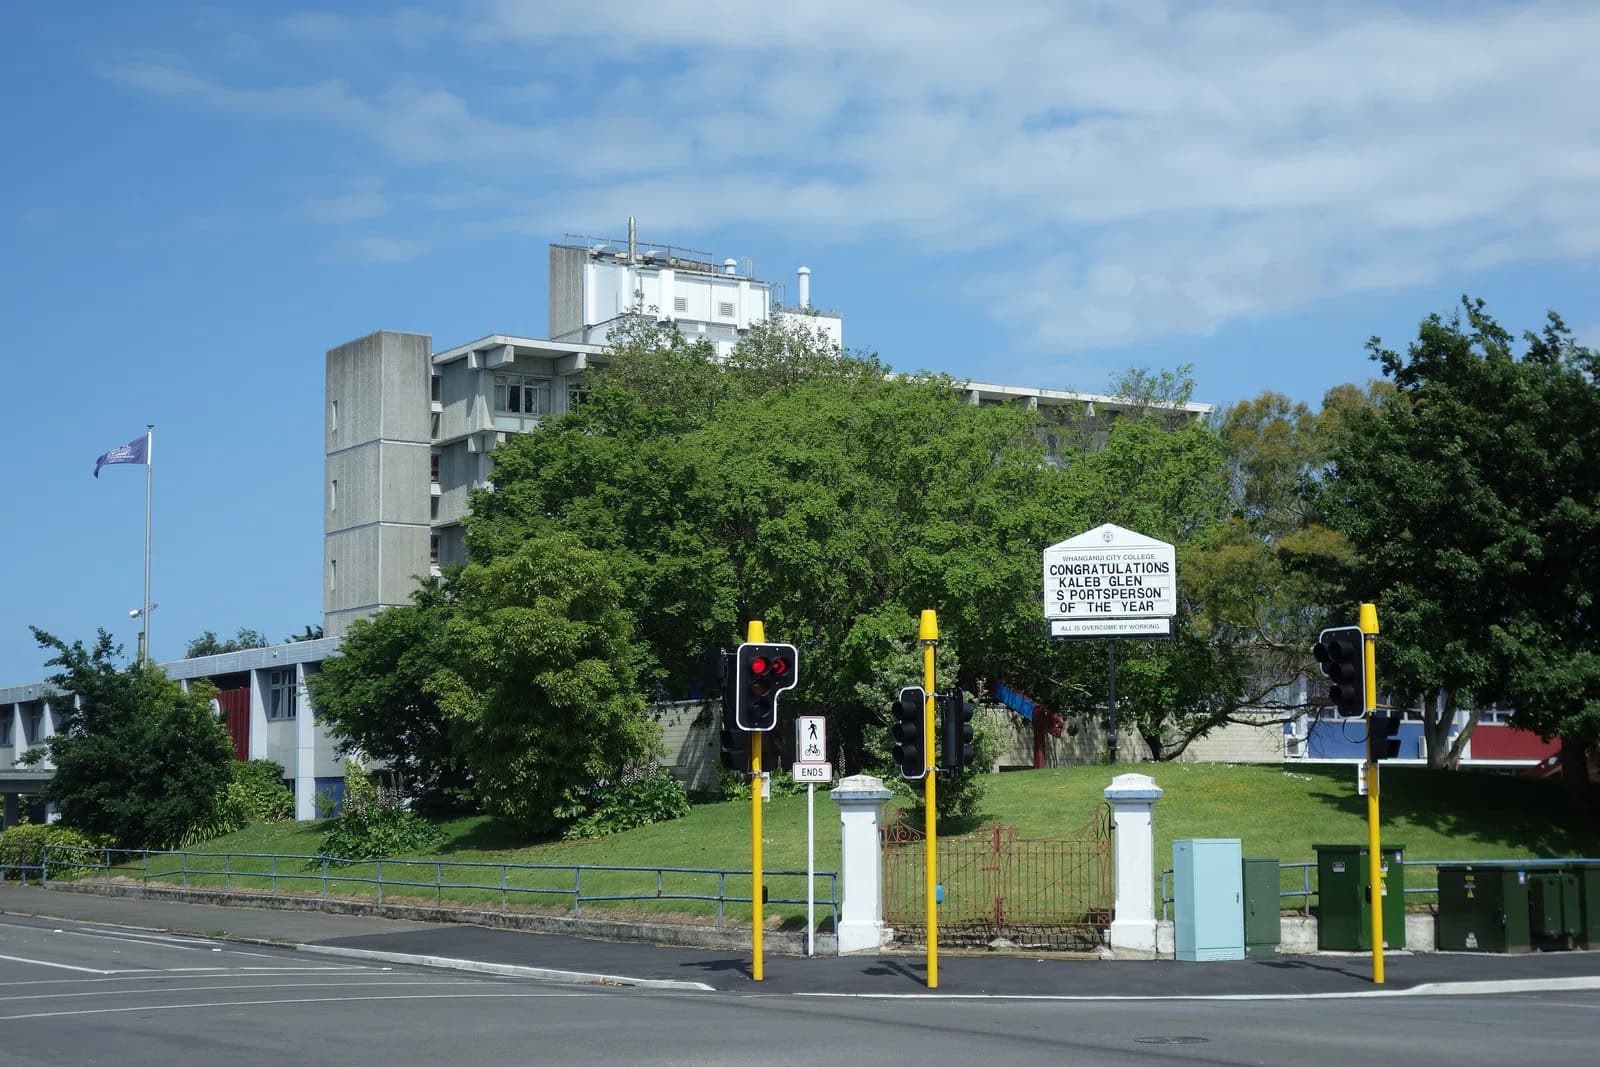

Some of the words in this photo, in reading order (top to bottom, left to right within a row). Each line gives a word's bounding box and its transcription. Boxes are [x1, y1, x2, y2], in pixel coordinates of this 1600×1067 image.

[1050, 562, 1169, 575] CONGRATULATIONS
[1059, 577, 1100, 587] KALEB
[1109, 576, 1142, 586] GLEN
[1060, 602, 1075, 613] OF
[1087, 602, 1111, 612] THE
[1121, 601, 1154, 612] YEAR
[802, 768, 823, 777] ENDS
